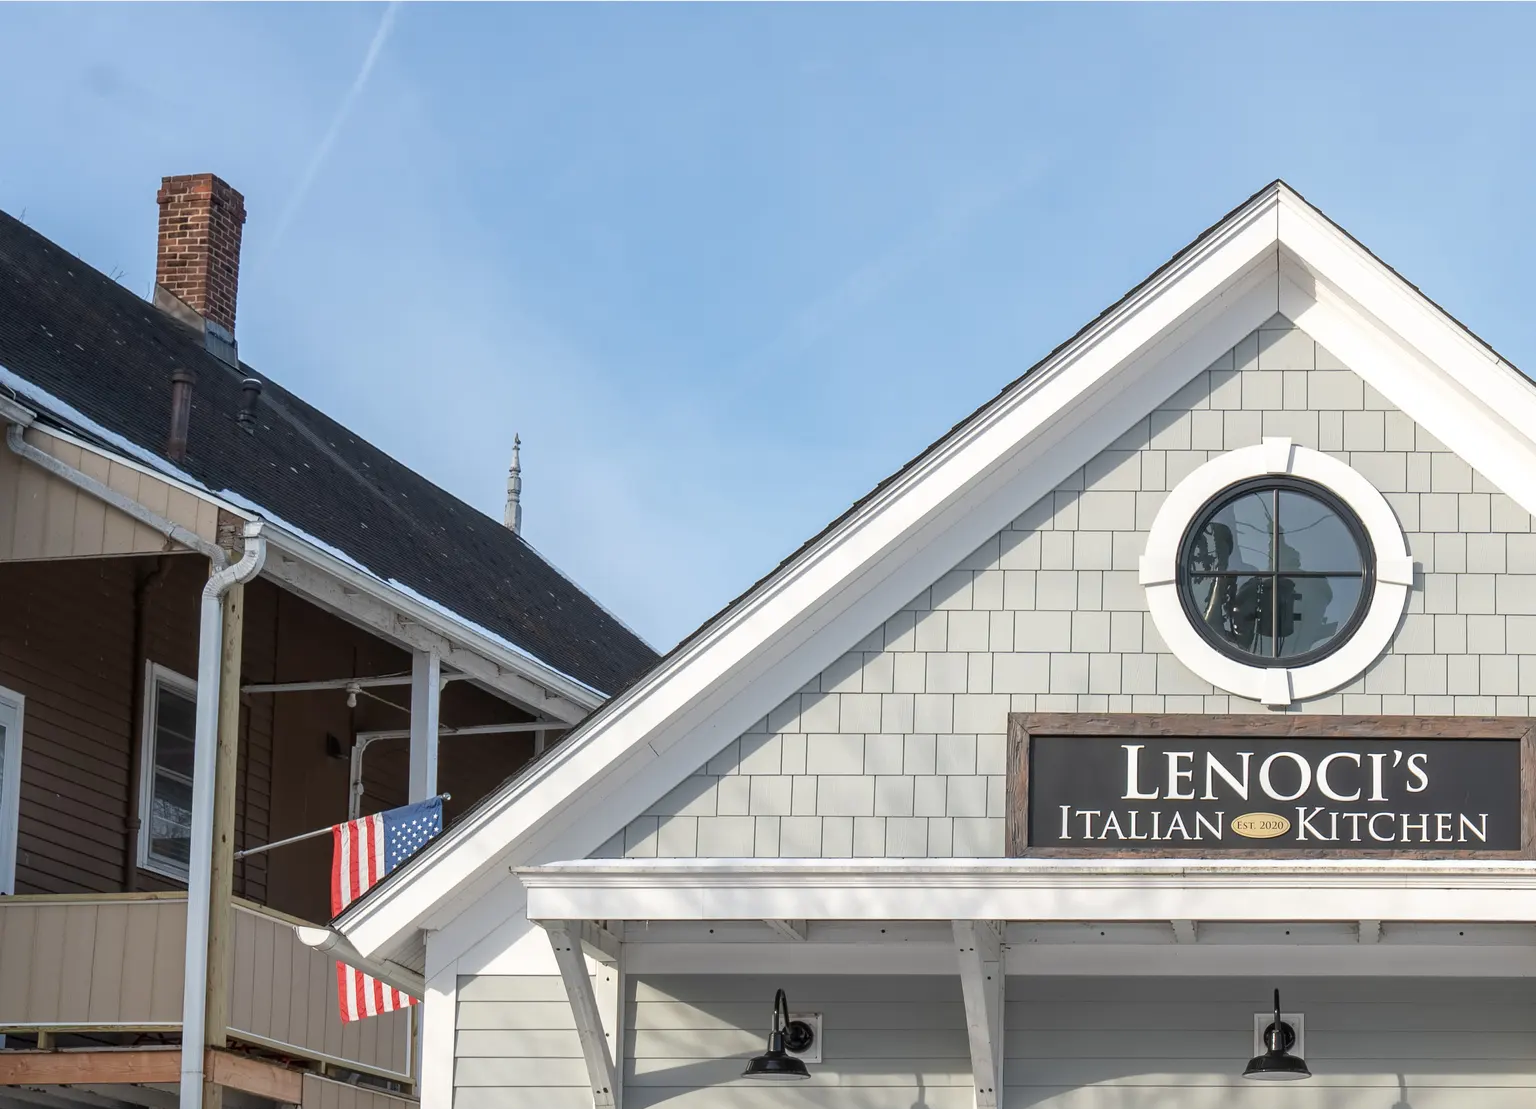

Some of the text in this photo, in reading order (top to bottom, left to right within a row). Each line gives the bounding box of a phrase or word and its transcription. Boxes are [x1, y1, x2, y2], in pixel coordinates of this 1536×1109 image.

[1121, 744, 1429, 801] LENOCI'S
[1059, 805, 1488, 842] ITALIAN KITCHEN
[1236, 820, 1285, 831] EST. 2020
